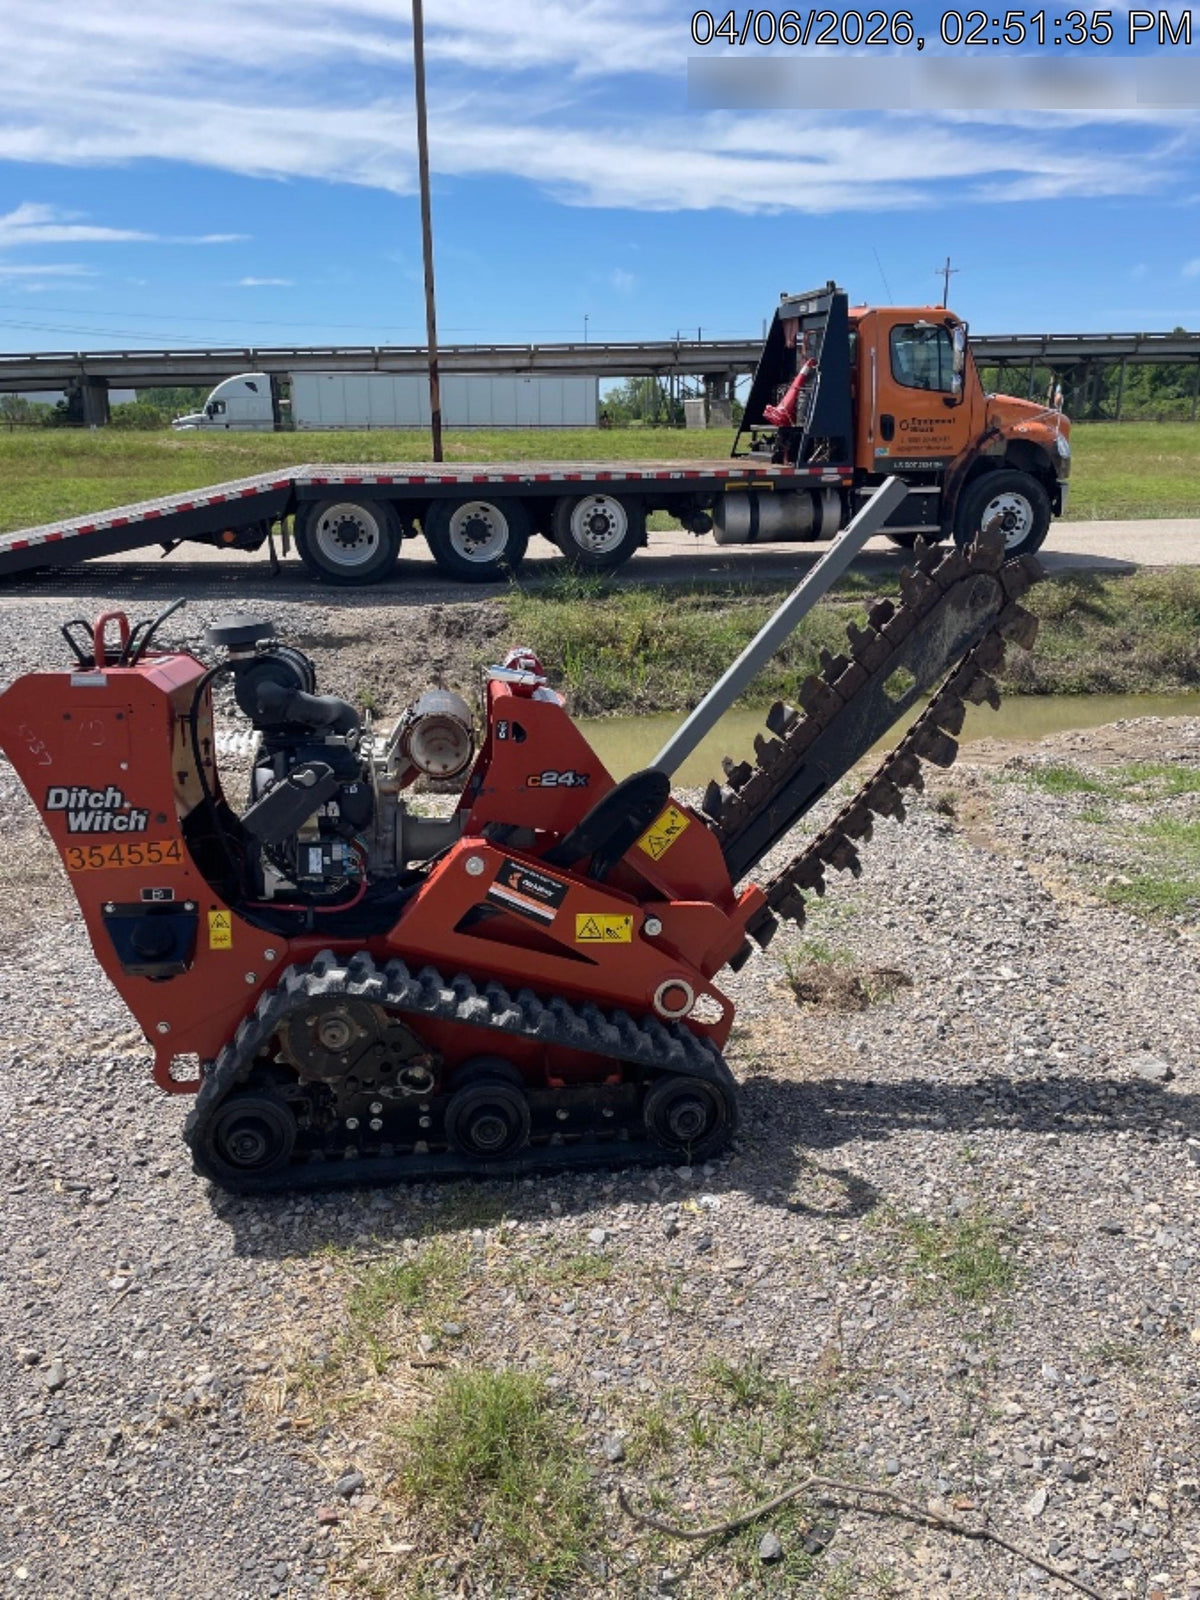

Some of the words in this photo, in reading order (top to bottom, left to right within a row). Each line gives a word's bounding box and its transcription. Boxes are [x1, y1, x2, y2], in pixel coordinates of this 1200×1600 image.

[47, 786, 122, 809] Ditch
[68, 809, 148, 832] Witch
[68, 840, 182, 870] 354554
